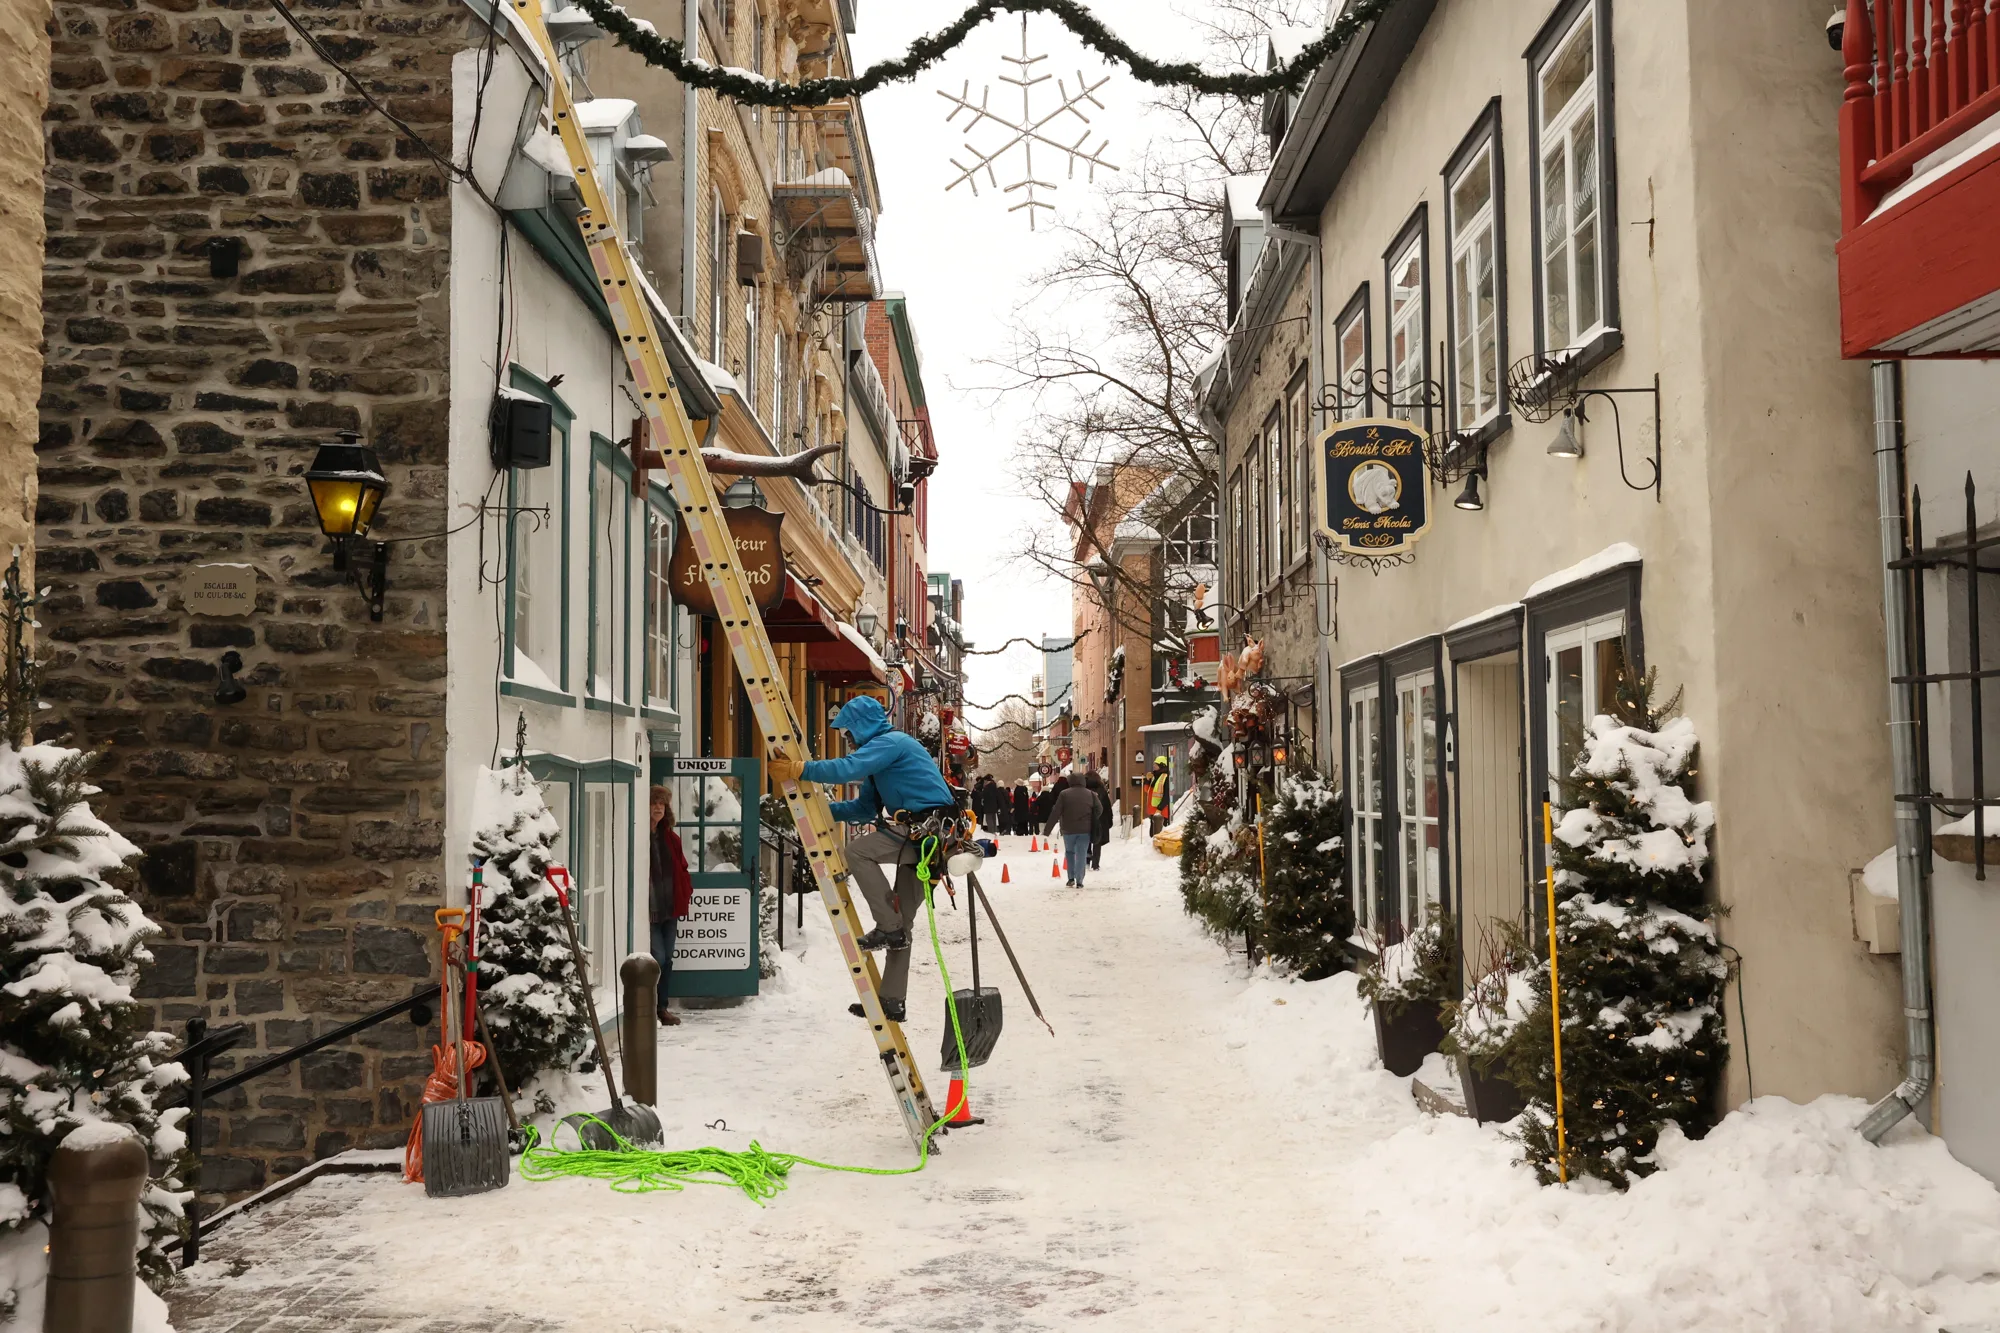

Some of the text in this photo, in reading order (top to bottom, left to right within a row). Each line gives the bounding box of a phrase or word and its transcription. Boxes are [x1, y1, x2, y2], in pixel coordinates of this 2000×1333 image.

[1381, 438, 1415, 457] Art
[1342, 516, 1411, 529] Denis Nicolas
[677, 761, 727, 771] UNIQUE
[690, 895, 741, 907] IQUE DE
[677, 912, 735, 922] ULPTURE
[676, 929, 728, 939] UR BOIS
[671, 948, 746, 959] ODCARVING
